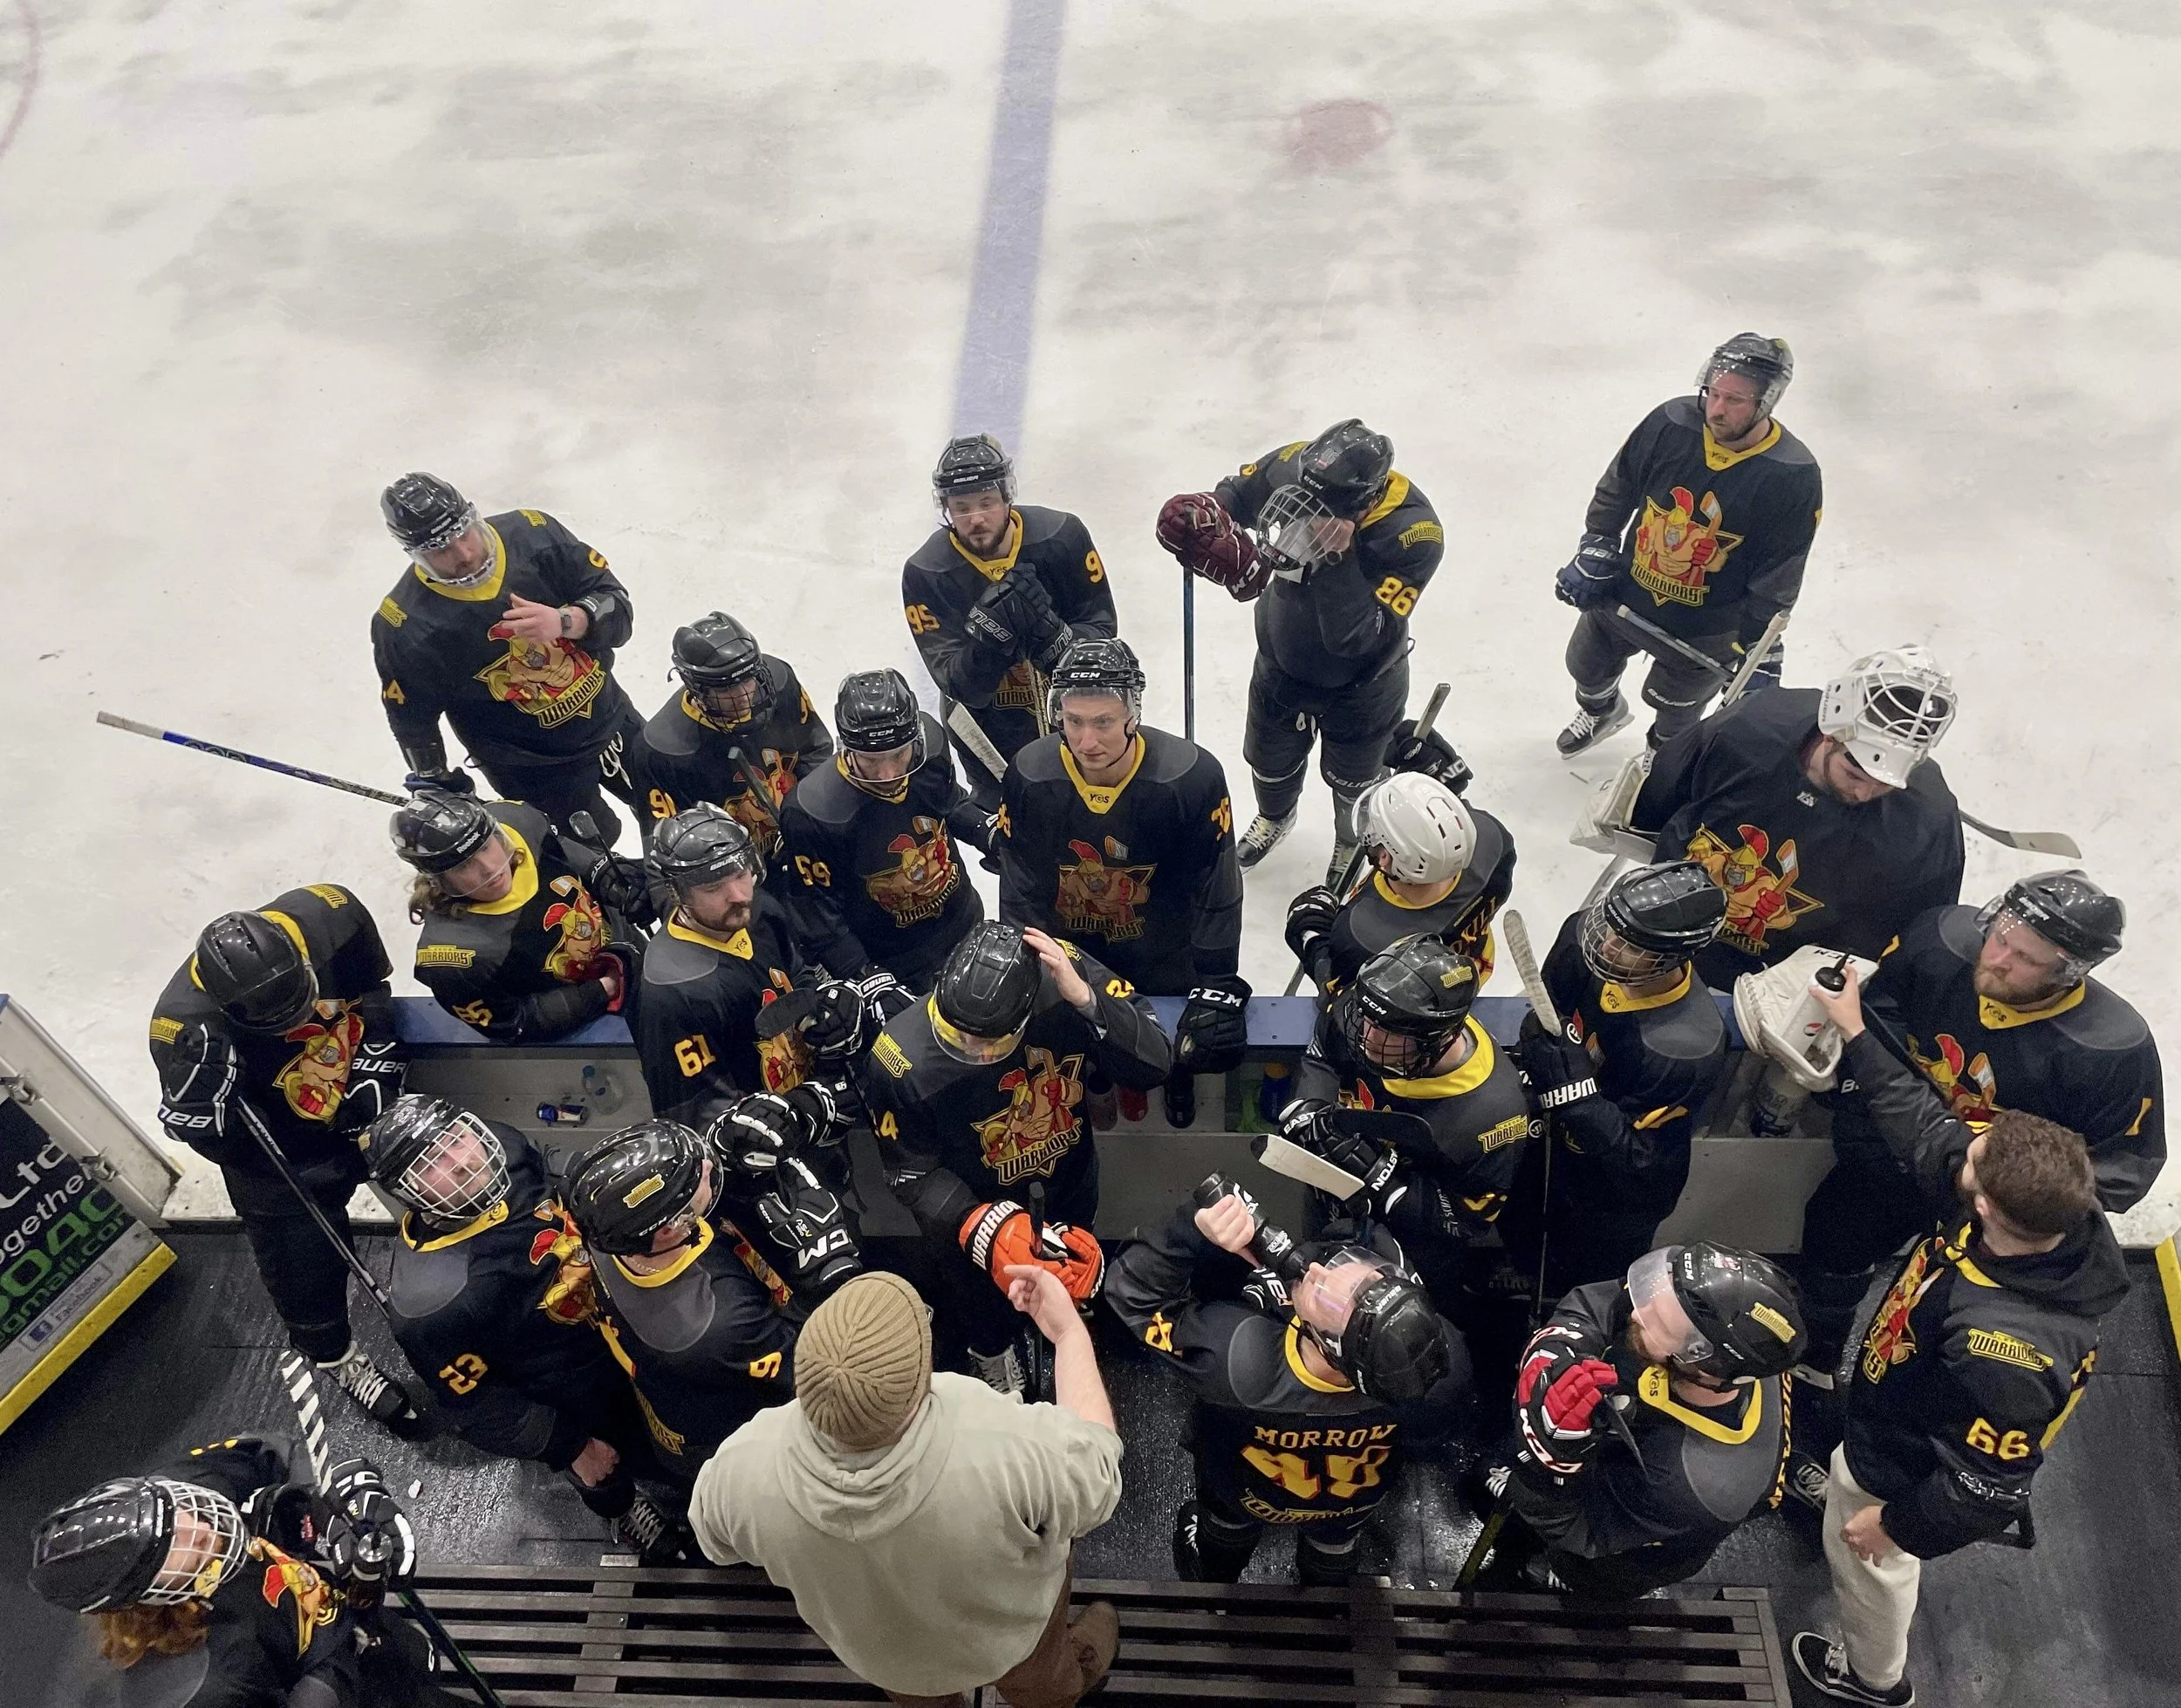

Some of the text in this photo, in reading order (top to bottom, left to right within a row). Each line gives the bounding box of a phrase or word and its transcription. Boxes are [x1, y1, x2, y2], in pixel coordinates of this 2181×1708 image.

[1634, 564, 1699, 602] WARRIORS
[1375, 577, 1419, 618] 86
[905, 604, 940, 635] 95
[869, 728, 894, 738] CCM
[455, 833, 481, 855] Reebok
[419, 951, 468, 965] WARRIORS
[863, 975, 893, 994] BAUER
[1187, 987, 1243, 1008] CCM
[1361, 995, 1387, 1015] CCM
[352, 1057, 405, 1074] AUER
[674, 1034, 716, 1077] 61
[1282, 1111, 1316, 1134] EAST
[797, 1228, 850, 1269] CM
[1683, 1251, 1694, 1281] CCM
[1254, 1424, 1398, 1449] MORROW
[1966, 1417, 2031, 1460] 66
